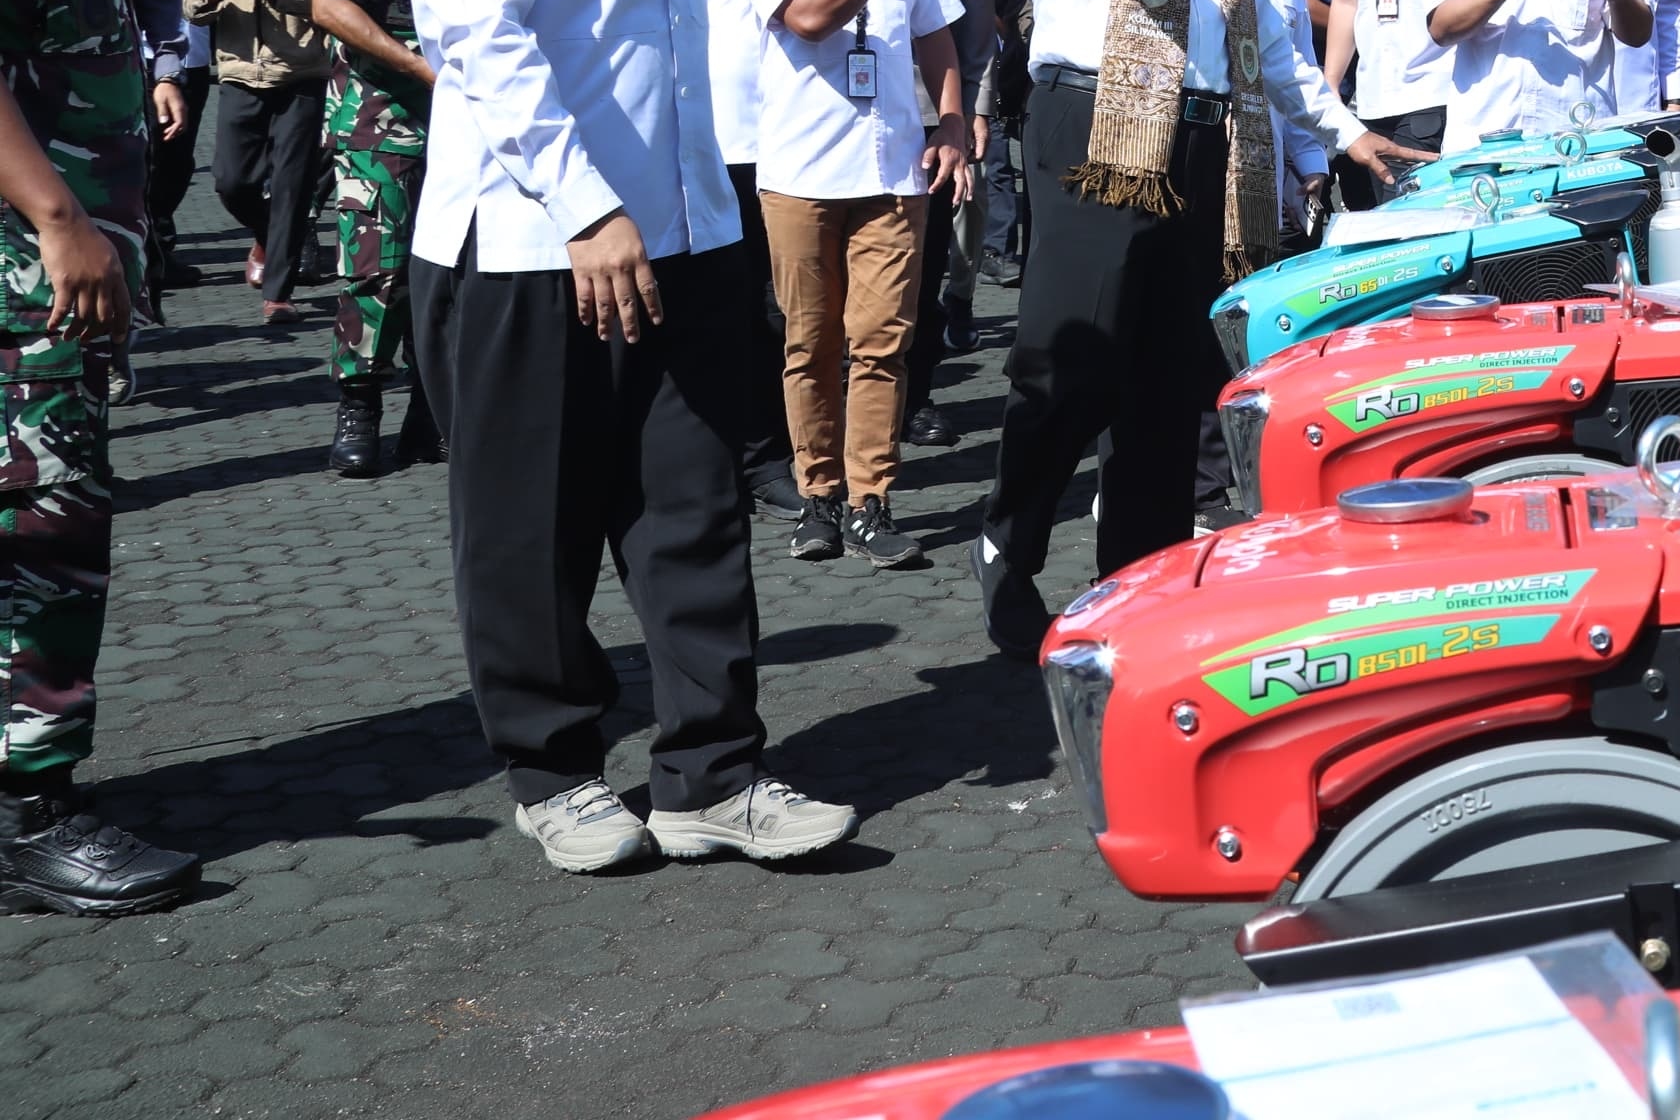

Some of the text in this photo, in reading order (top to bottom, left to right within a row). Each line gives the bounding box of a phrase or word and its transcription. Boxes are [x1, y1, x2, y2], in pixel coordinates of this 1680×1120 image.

[1129, 13, 1163, 29] KODAM
[1124, 23, 1174, 41] SILIWANGI
[1567, 162, 1623, 179] KUBOTA
[1380, 243, 1431, 261] POWER
[1405, 347, 1558, 370] SUPER POWER
[1479, 356, 1558, 368] DIRECT INJECTION
[1327, 574, 1567, 614] SUPER POWER
[1446, 588, 1569, 611] DIRECT INJECTION
[1249, 647, 1351, 700] RD
